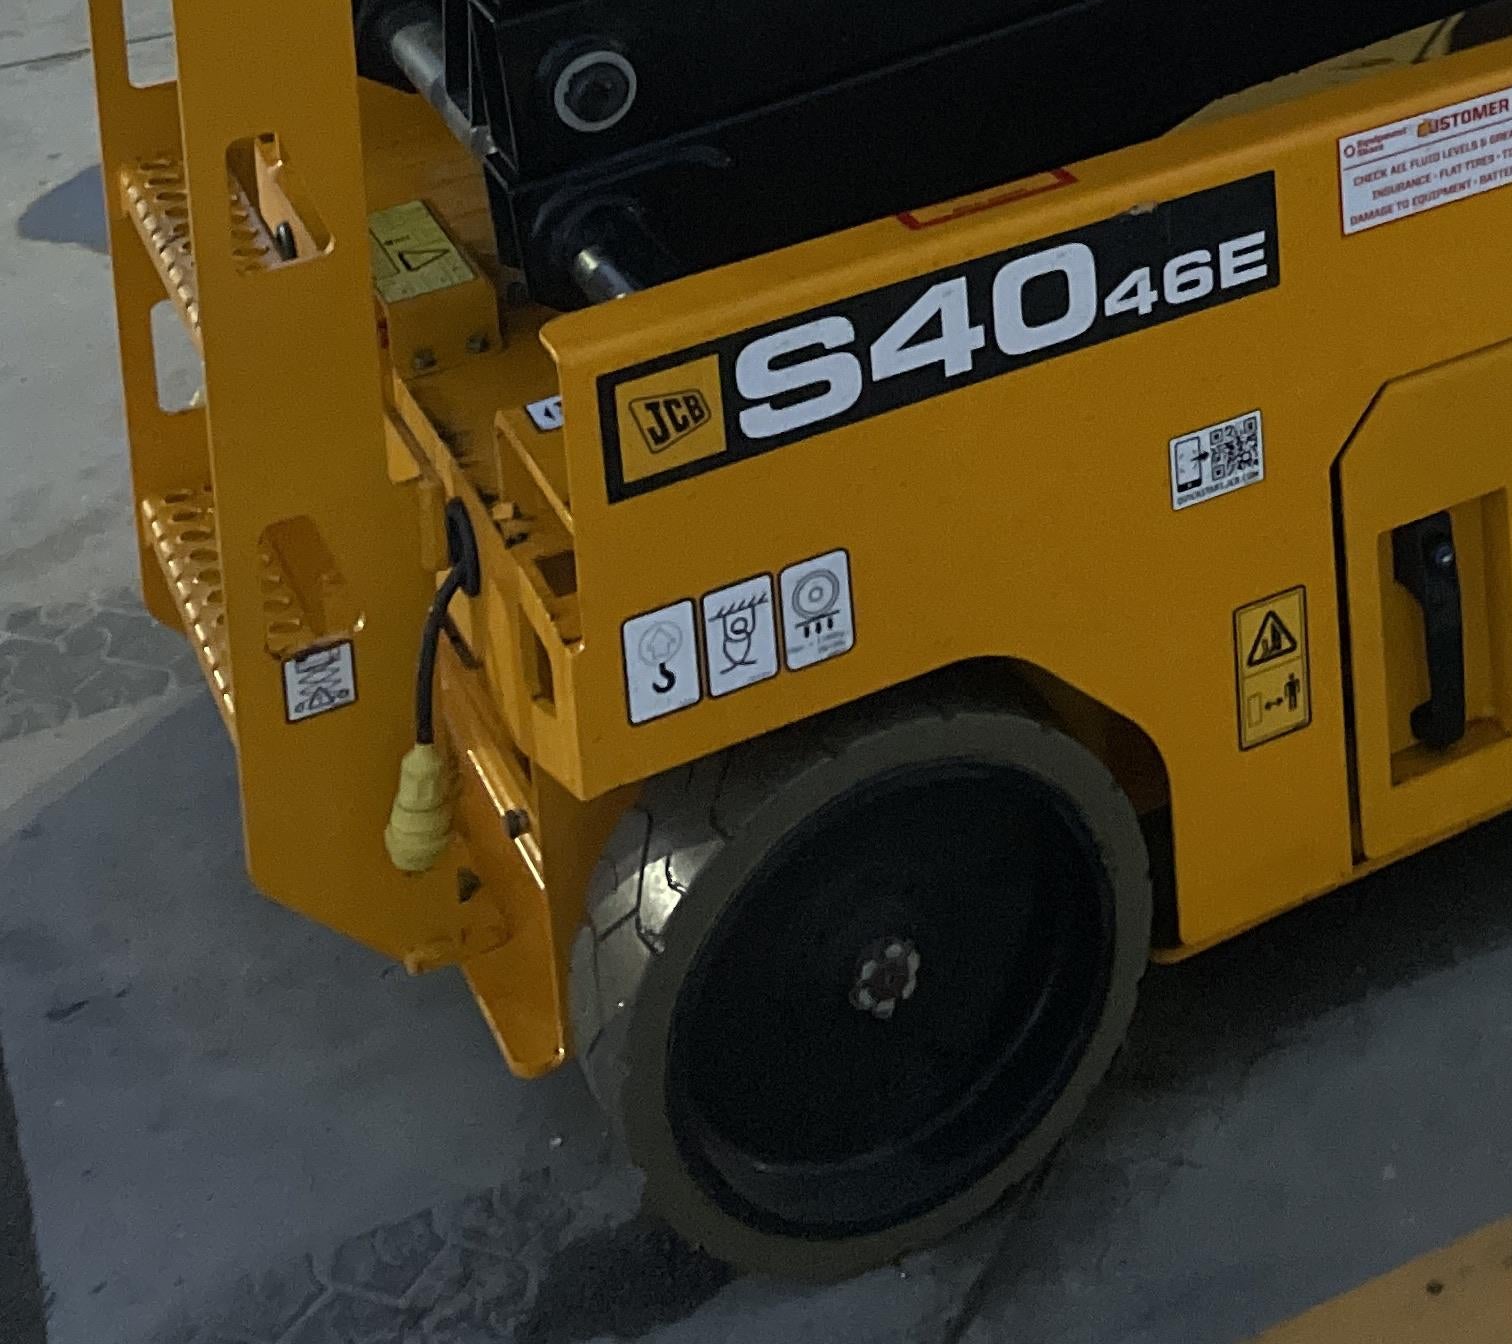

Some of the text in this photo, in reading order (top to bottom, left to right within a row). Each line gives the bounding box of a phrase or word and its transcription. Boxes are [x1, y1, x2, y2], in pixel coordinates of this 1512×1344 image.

[1417, 98, 1509, 138] USTOMER
[1353, 168, 1388, 187] CHECK
[1410, 152, 1440, 170] FLUID
[1442, 140, 1478, 161] LEVELS
[1372, 173, 1432, 201] INSURANCE
[1439, 164, 1462, 179] FLAT
[1350, 202, 1394, 226] DAMAGE
[1397, 198, 1410, 211] TO
[1411, 179, 1473, 208] EQUIPMENT
[645, 391, 706, 445] JCB
